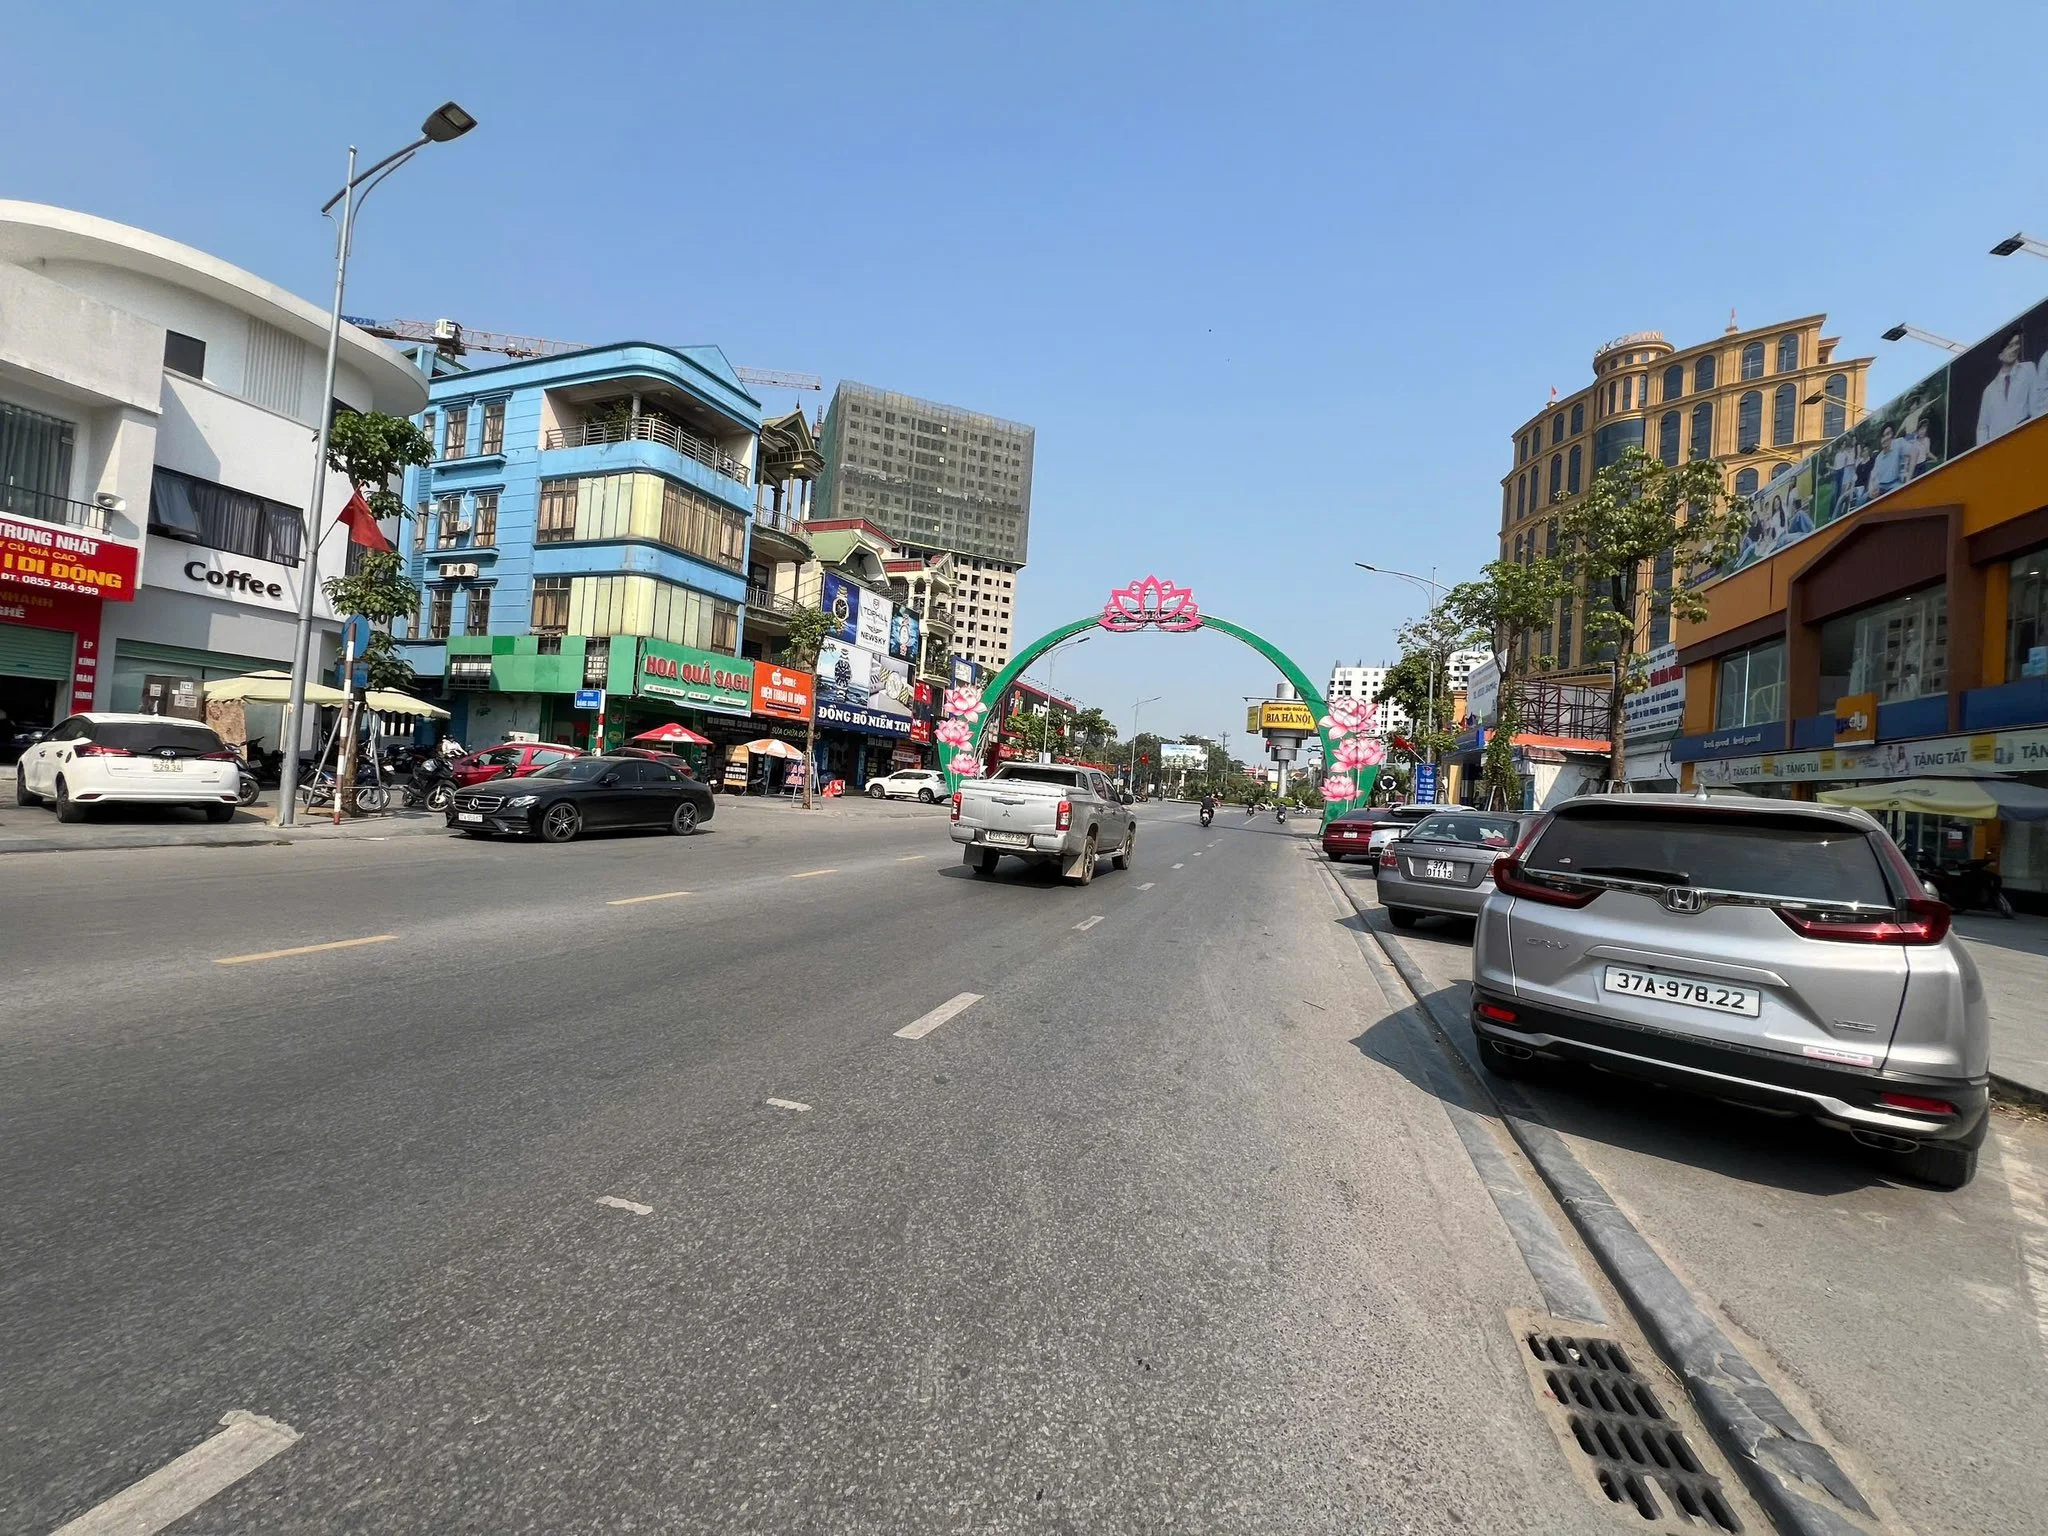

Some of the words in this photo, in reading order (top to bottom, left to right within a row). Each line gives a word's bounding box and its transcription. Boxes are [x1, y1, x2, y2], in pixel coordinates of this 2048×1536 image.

[0, 522, 52, 546] TRUNG
[56, 535, 99, 556] NHẬT
[52, 552, 77, 562] CAO
[17, 555, 45, 574] DI
[51, 562, 122, 589] ĐỘNG
[184, 561, 282, 598] Coffee
[22, 575, 51, 587] 0855
[53, 581, 75, 592] 284
[78, 585, 99, 595] 999
[860, 631, 886, 645] NEWSKY
[644, 655, 678, 679] HOA
[681, 661, 711, 685] QUẢ
[714, 669, 750, 695] SẠCH
[818, 703, 851, 723] ĐỒNG
[851, 711, 867, 725] HỒ
[869, 714, 893, 730] NIỀM
[894, 720, 911, 733] TIN
[1266, 713, 1280, 723] BIA
[1282, 712, 1294, 723] HÀ
[1296, 713, 1311, 726] NỘI
[1786, 763, 1805, 774] TẶNG
[1806, 762, 1819, 773] TÚI
[1914, 751, 1944, 769] TẶNG
[1945, 747, 1967, 764] TẤT
[1733, 767, 1749, 778] TẶNG
[1749, 764, 1761, 776] TẤT
[1433, 860, 1447, 869] 37A
[1617, 973, 1746, 1010] 37A-978.22
